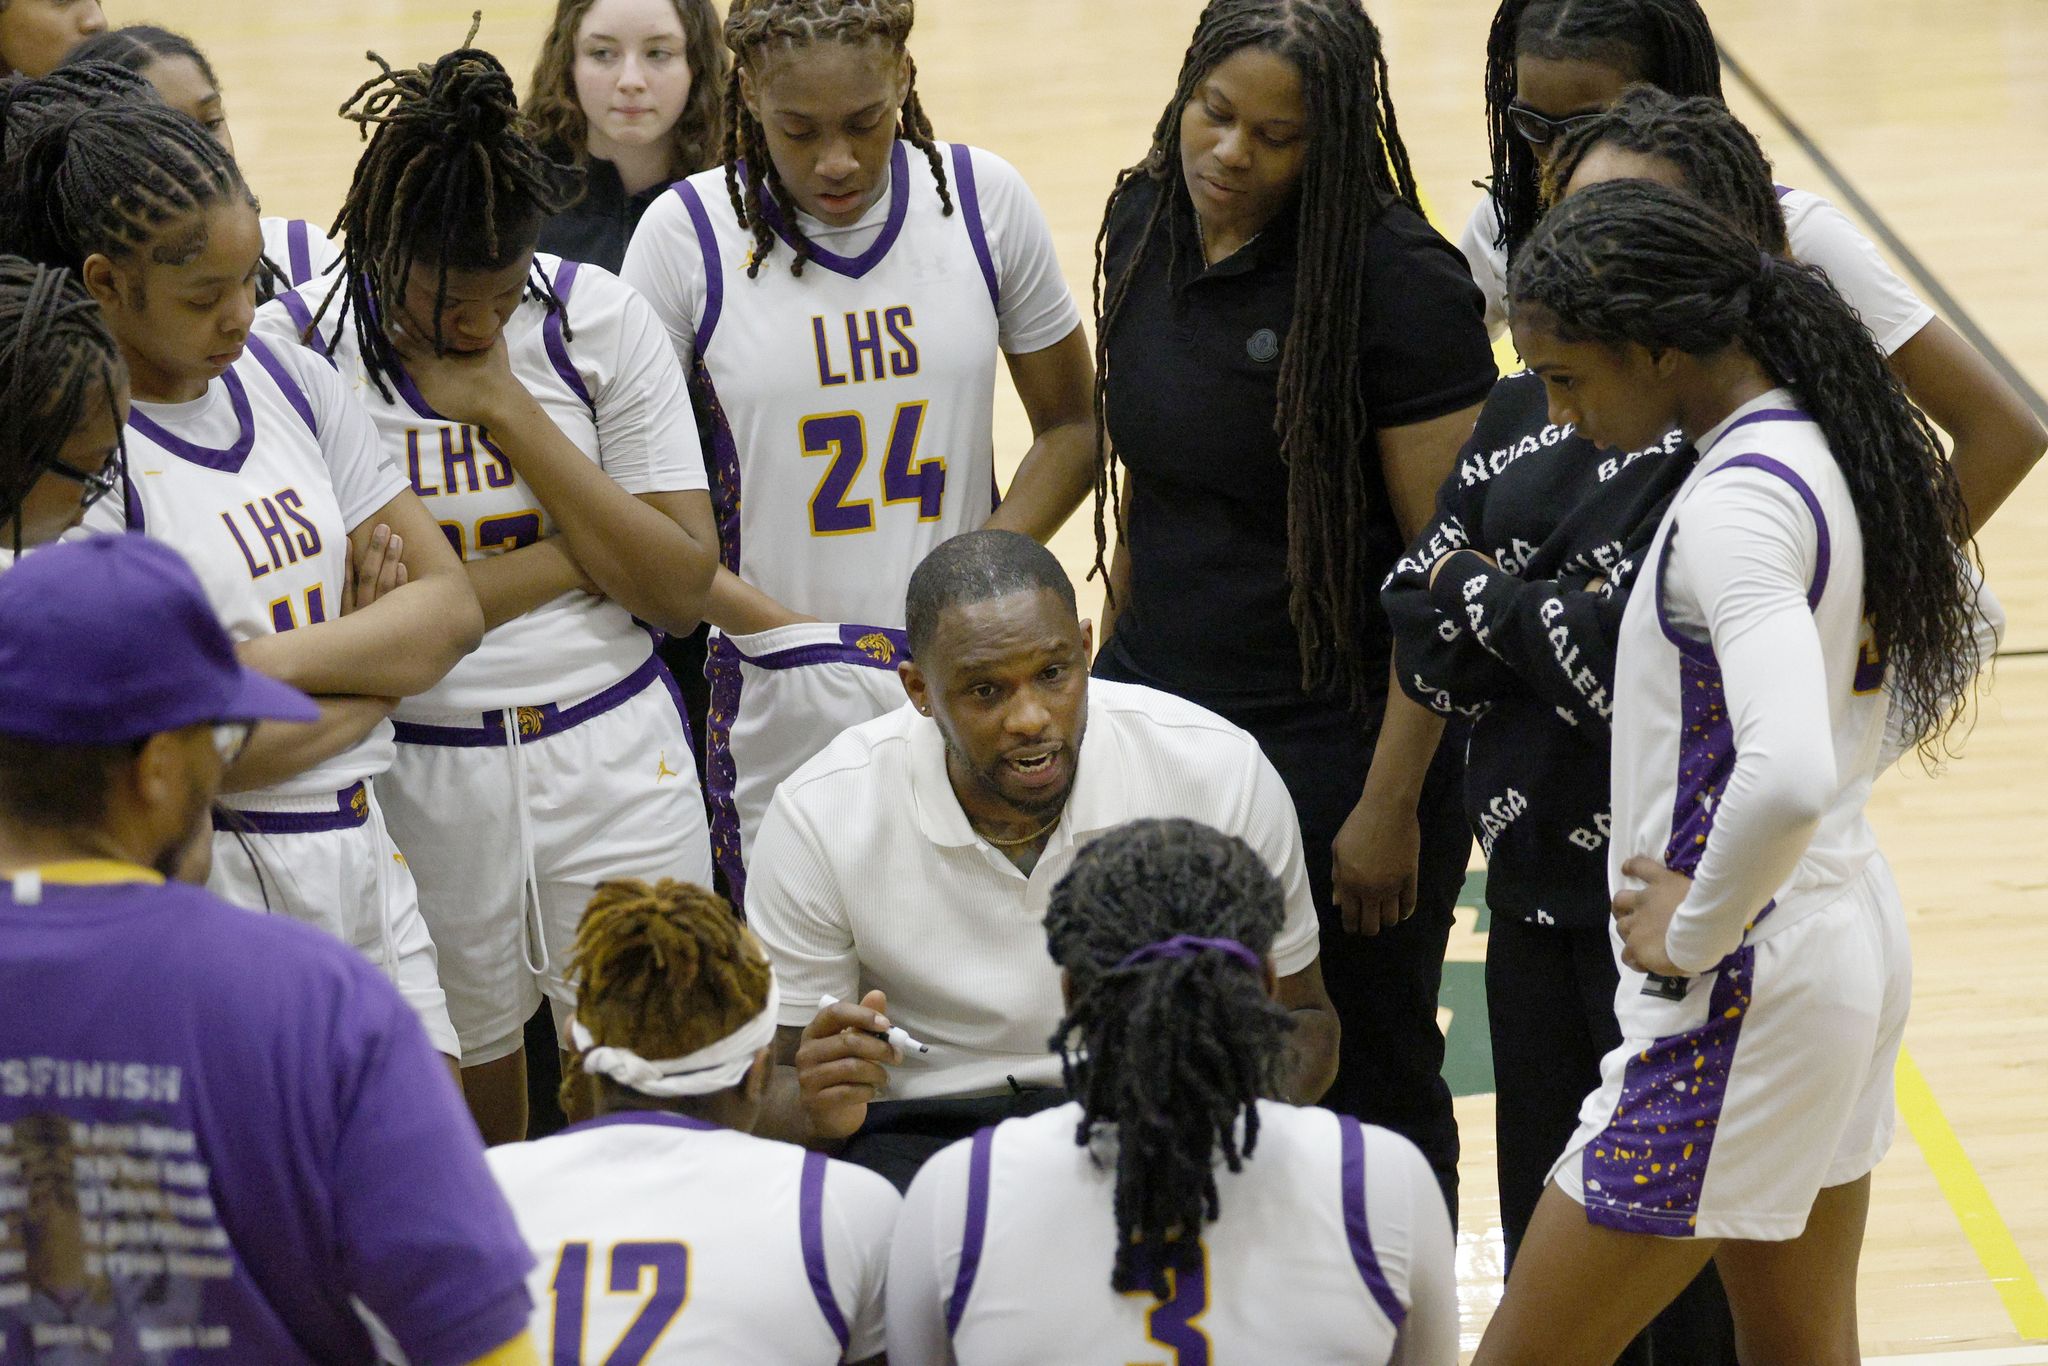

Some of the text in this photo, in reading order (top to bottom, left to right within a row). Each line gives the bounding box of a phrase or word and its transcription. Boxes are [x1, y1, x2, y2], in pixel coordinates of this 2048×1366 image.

[811, 304, 920, 388] LHS
[405, 424, 518, 496] LHS
[798, 400, 947, 537] 24
[219, 486, 322, 581] LHS
[547, 1239, 691, 1366] 12
